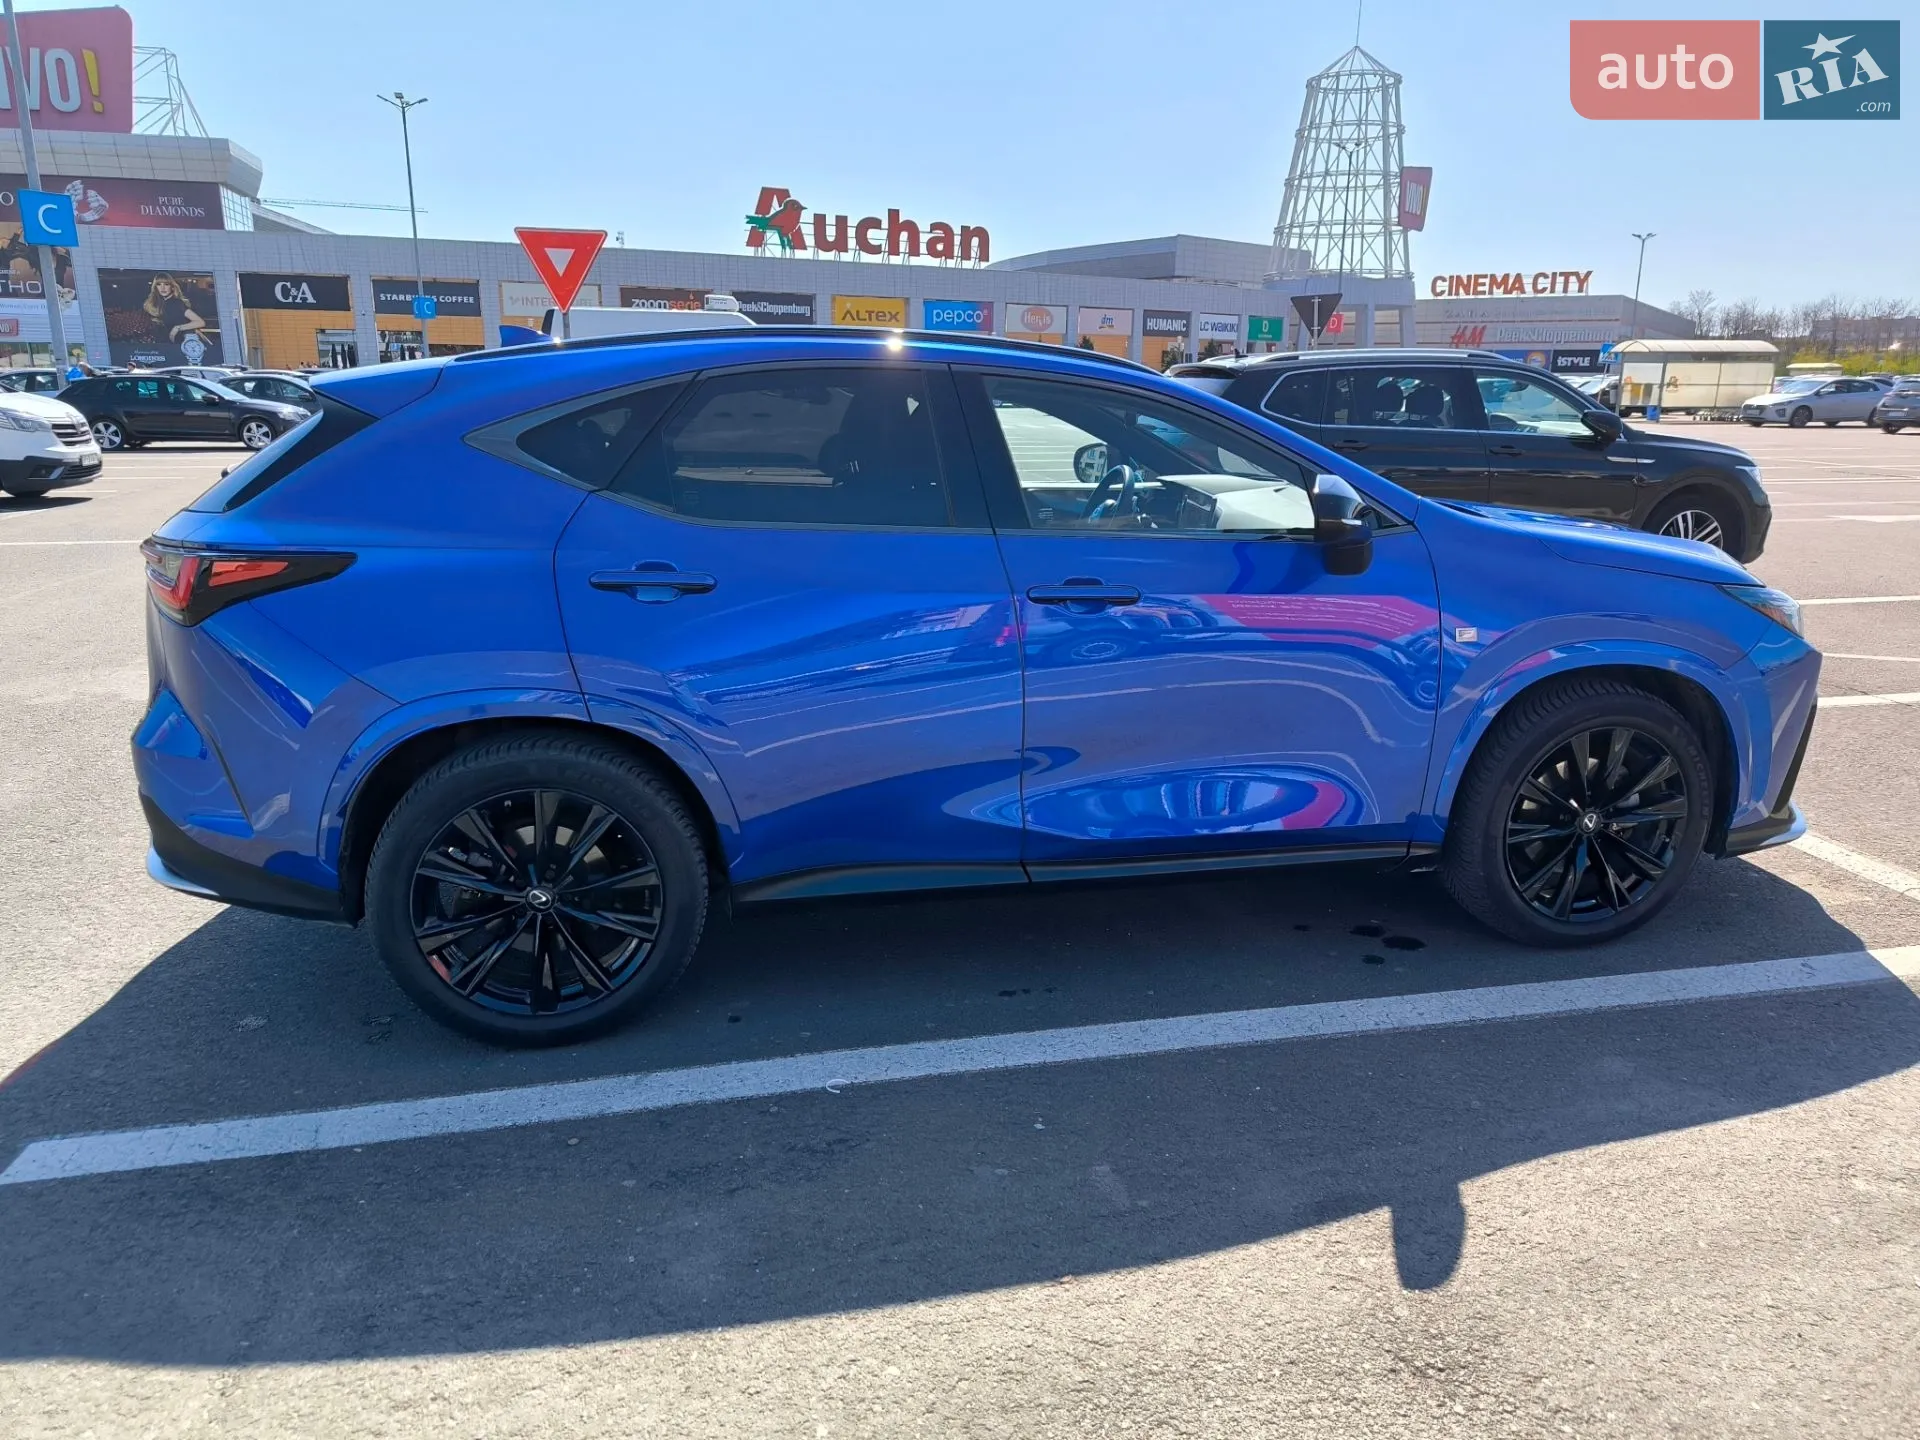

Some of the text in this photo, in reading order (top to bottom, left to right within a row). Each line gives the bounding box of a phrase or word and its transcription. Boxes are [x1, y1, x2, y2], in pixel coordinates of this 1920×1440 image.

[158, 196, 185, 206] PURE
[140, 205, 206, 217] DIAMONDS
[38, 203, 62, 234] C
[745, 186, 990, 262] Auchan
[1431, 270, 1593, 297] CINEMA CITY
[274, 281, 317, 304] C&A
[379, 293, 475, 303] STARBS COFFEE
[424, 301, 432, 314] C
[932, 309, 984, 326] pepco
[1101, 313, 1114, 325] dm
[1146, 317, 1187, 332] HUMANIC
[1199, 321, 1210, 331] LC
[1557, 356, 1591, 367] iSTYLE
